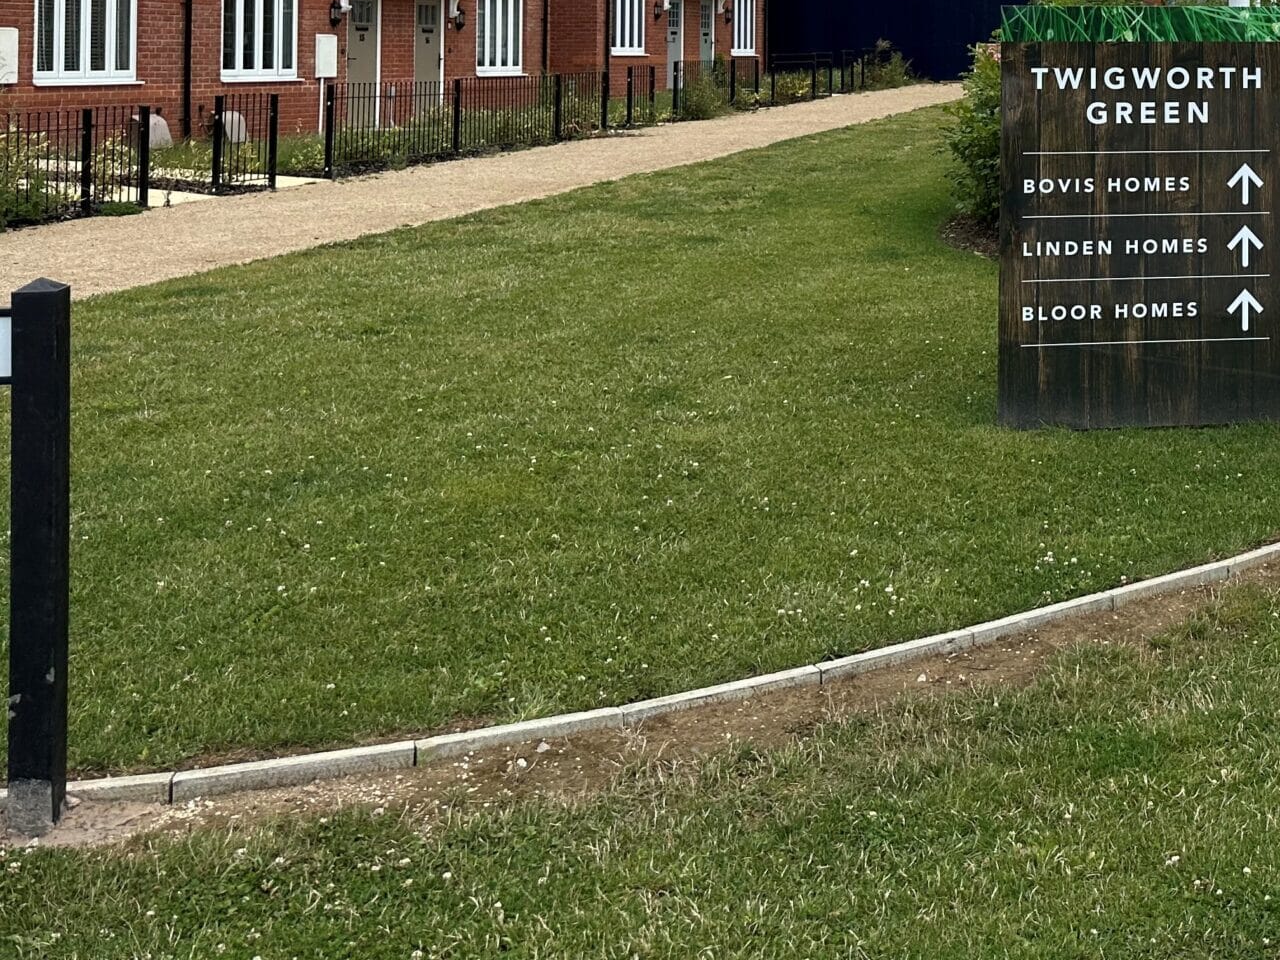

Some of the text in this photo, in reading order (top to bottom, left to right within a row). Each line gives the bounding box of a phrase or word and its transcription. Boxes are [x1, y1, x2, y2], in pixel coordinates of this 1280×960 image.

[1030, 67, 1262, 90] TWIGWORTH
[1086, 101, 1209, 125] GREEN
[1023, 176, 1190, 194] BOVIS HOMES
[1022, 238, 1208, 257] LINDEN HOMES
[1021, 302, 1198, 321] BLOOR HOMES
